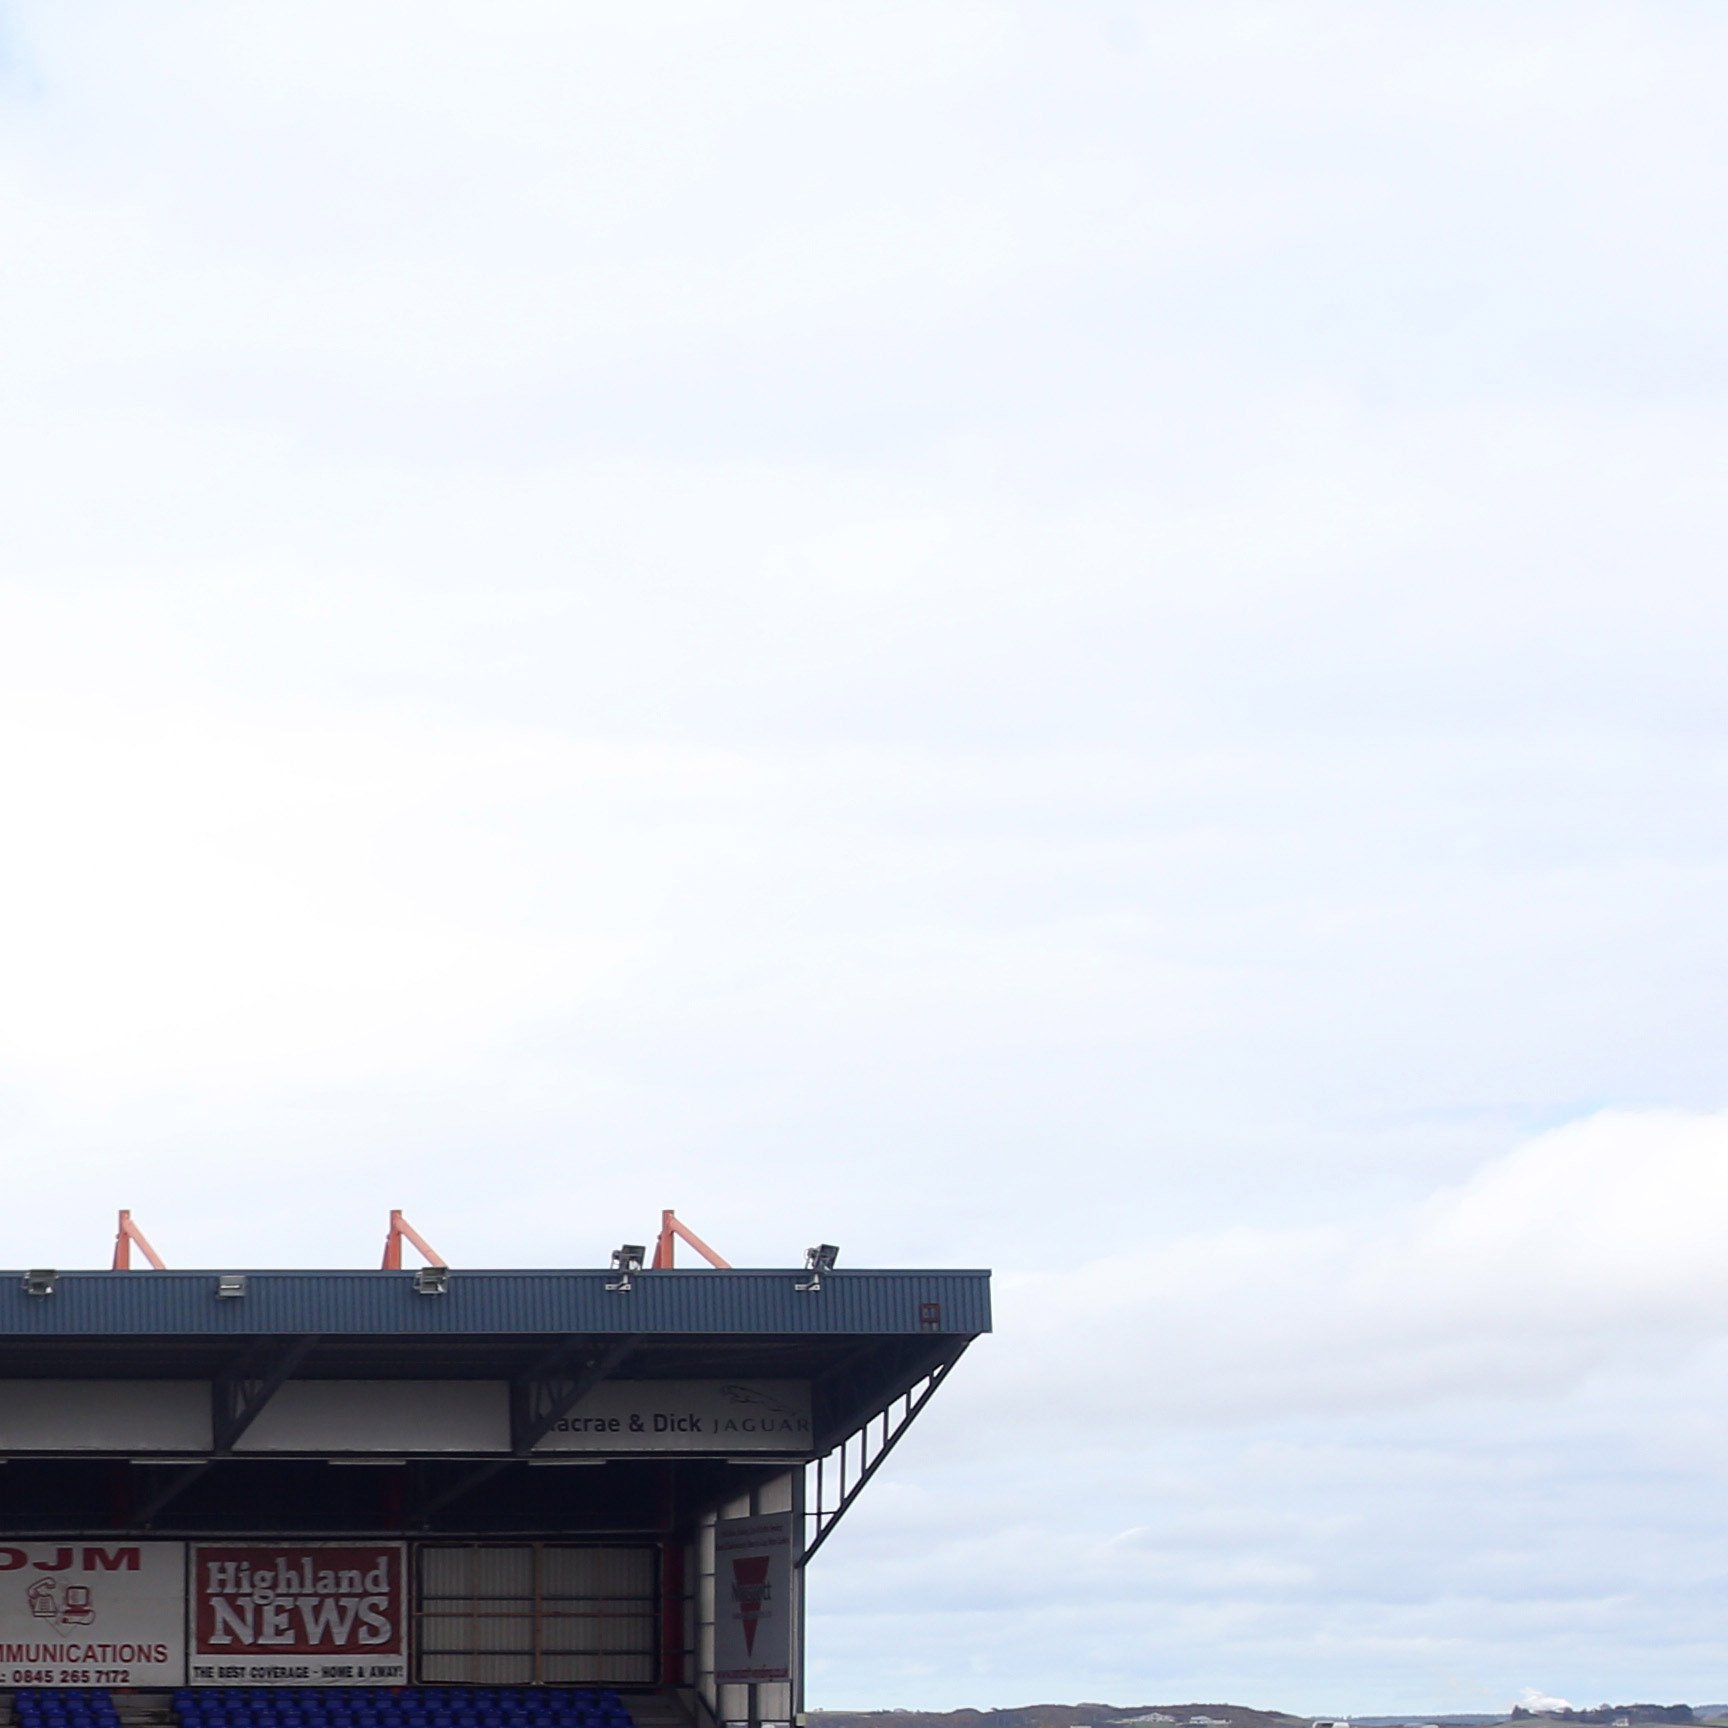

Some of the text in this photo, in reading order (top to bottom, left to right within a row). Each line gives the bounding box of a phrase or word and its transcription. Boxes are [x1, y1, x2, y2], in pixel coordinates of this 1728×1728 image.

[629, 1414, 808, 1433] & Dick JAGUAR
[205, 1556, 391, 1605] Highland
[207, 1596, 392, 1646] NEWS
[12, 1670, 53, 1683] 0845
[60, 1670, 90, 1683] 265
[194, 1666, 309, 1678] THE BEST COVERAGE
